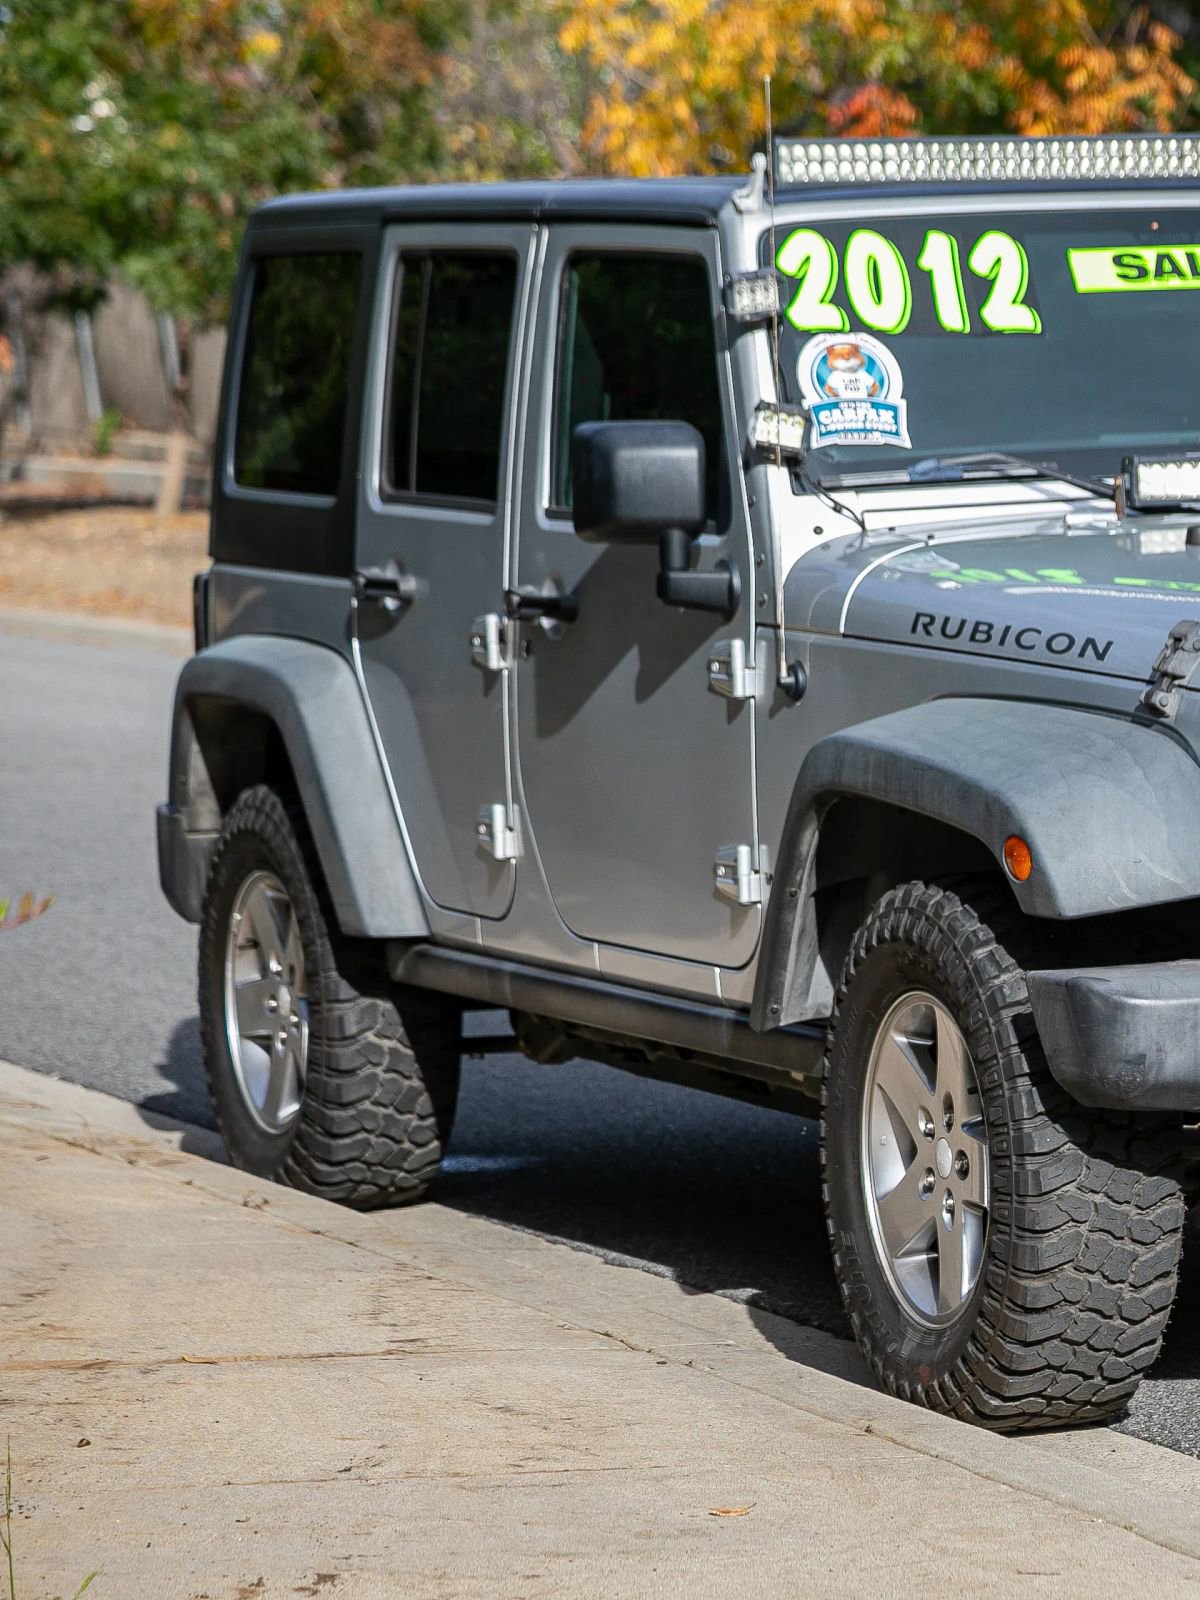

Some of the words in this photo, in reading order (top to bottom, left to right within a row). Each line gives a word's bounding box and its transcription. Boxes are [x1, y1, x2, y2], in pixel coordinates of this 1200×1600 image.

[776, 228, 1042, 335] 2012
[818, 407, 895, 425] CARFAX
[910, 612, 1114, 662] RUBICON
